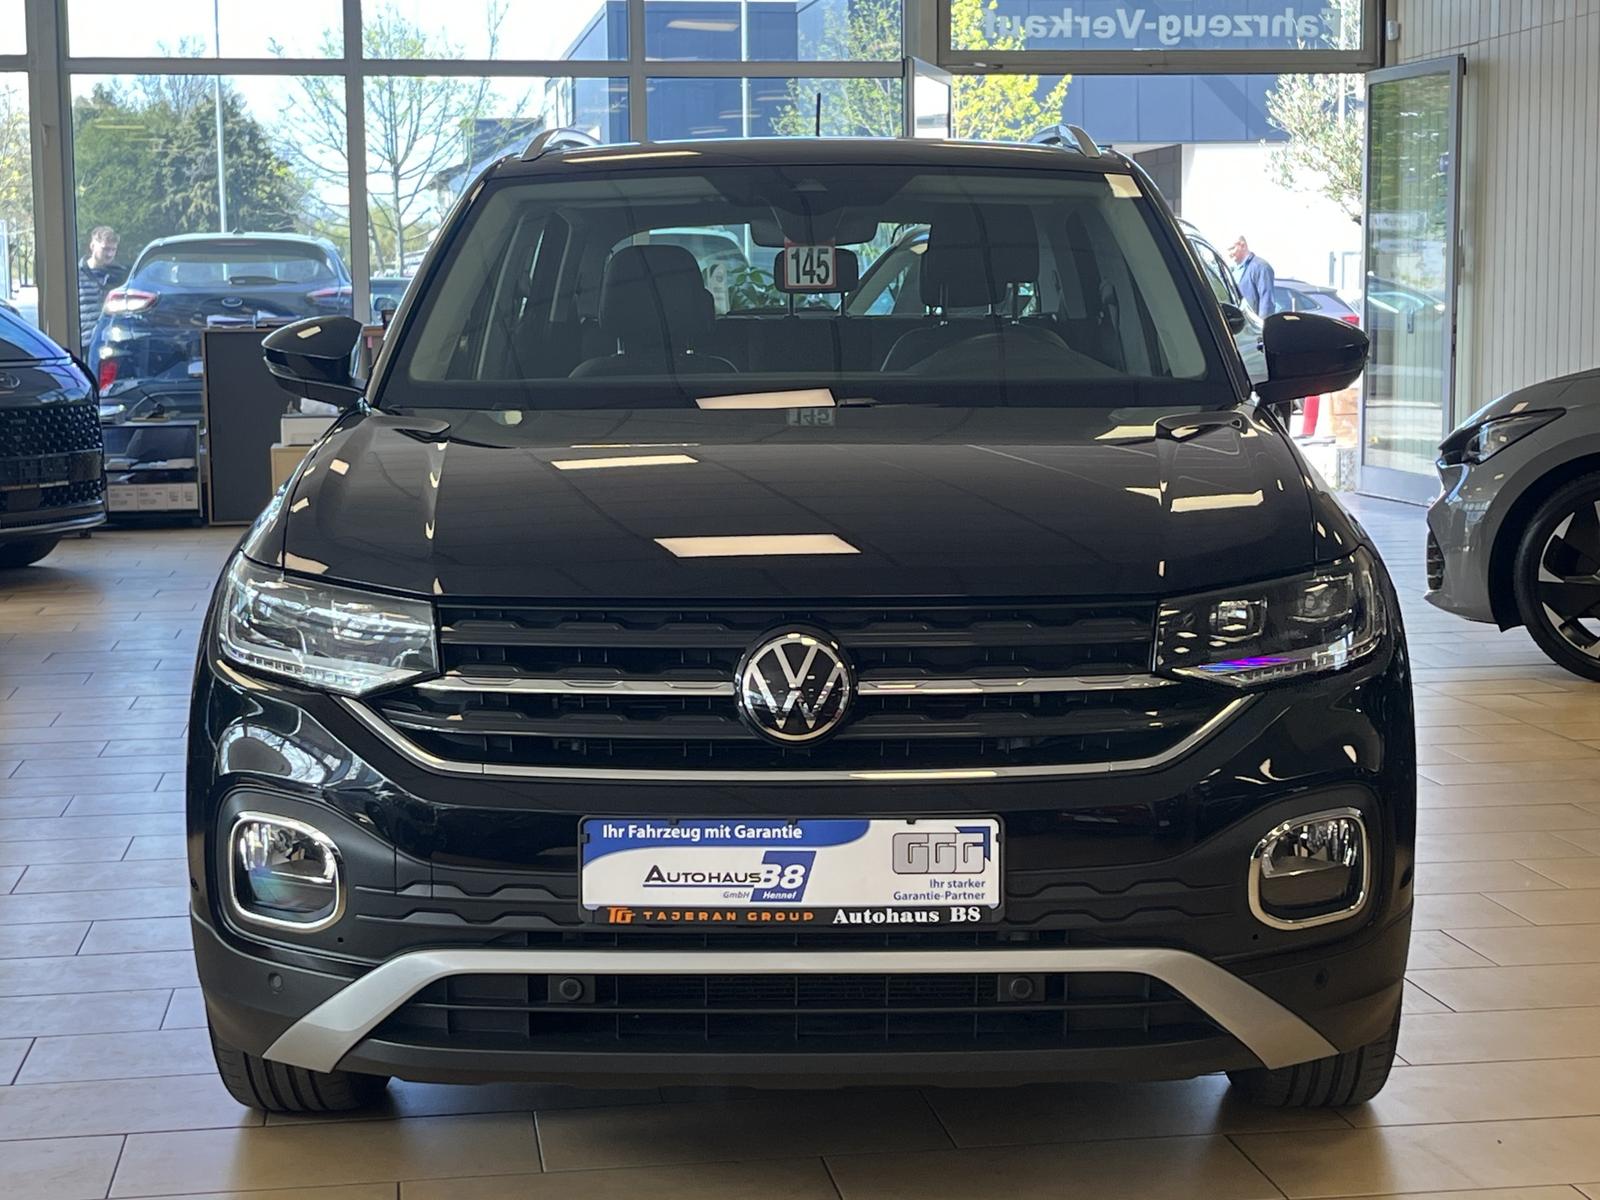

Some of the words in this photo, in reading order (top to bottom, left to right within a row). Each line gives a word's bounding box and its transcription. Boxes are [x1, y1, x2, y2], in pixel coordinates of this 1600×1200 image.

[791, 248, 830, 284] 145
[603, 825, 625, 838] Ihr
[628, 825, 700, 841] Fahrzeug
[705, 825, 731, 838] mit
[734, 825, 803, 839] Garantie
[761, 863, 806, 890] B8
[929, 879, 945, 888] Ihr
[947, 879, 986, 888] starker
[722, 891, 750, 899] GmbH
[762, 891, 797, 900] Hennef
[893, 891, 986, 901] Garantie-Partner
[643, 911, 736, 921] TAJERAN
[747, 911, 814, 921] GROUP
[832, 907, 940, 924] Autohaus
[949, 906, 982, 922] B8
